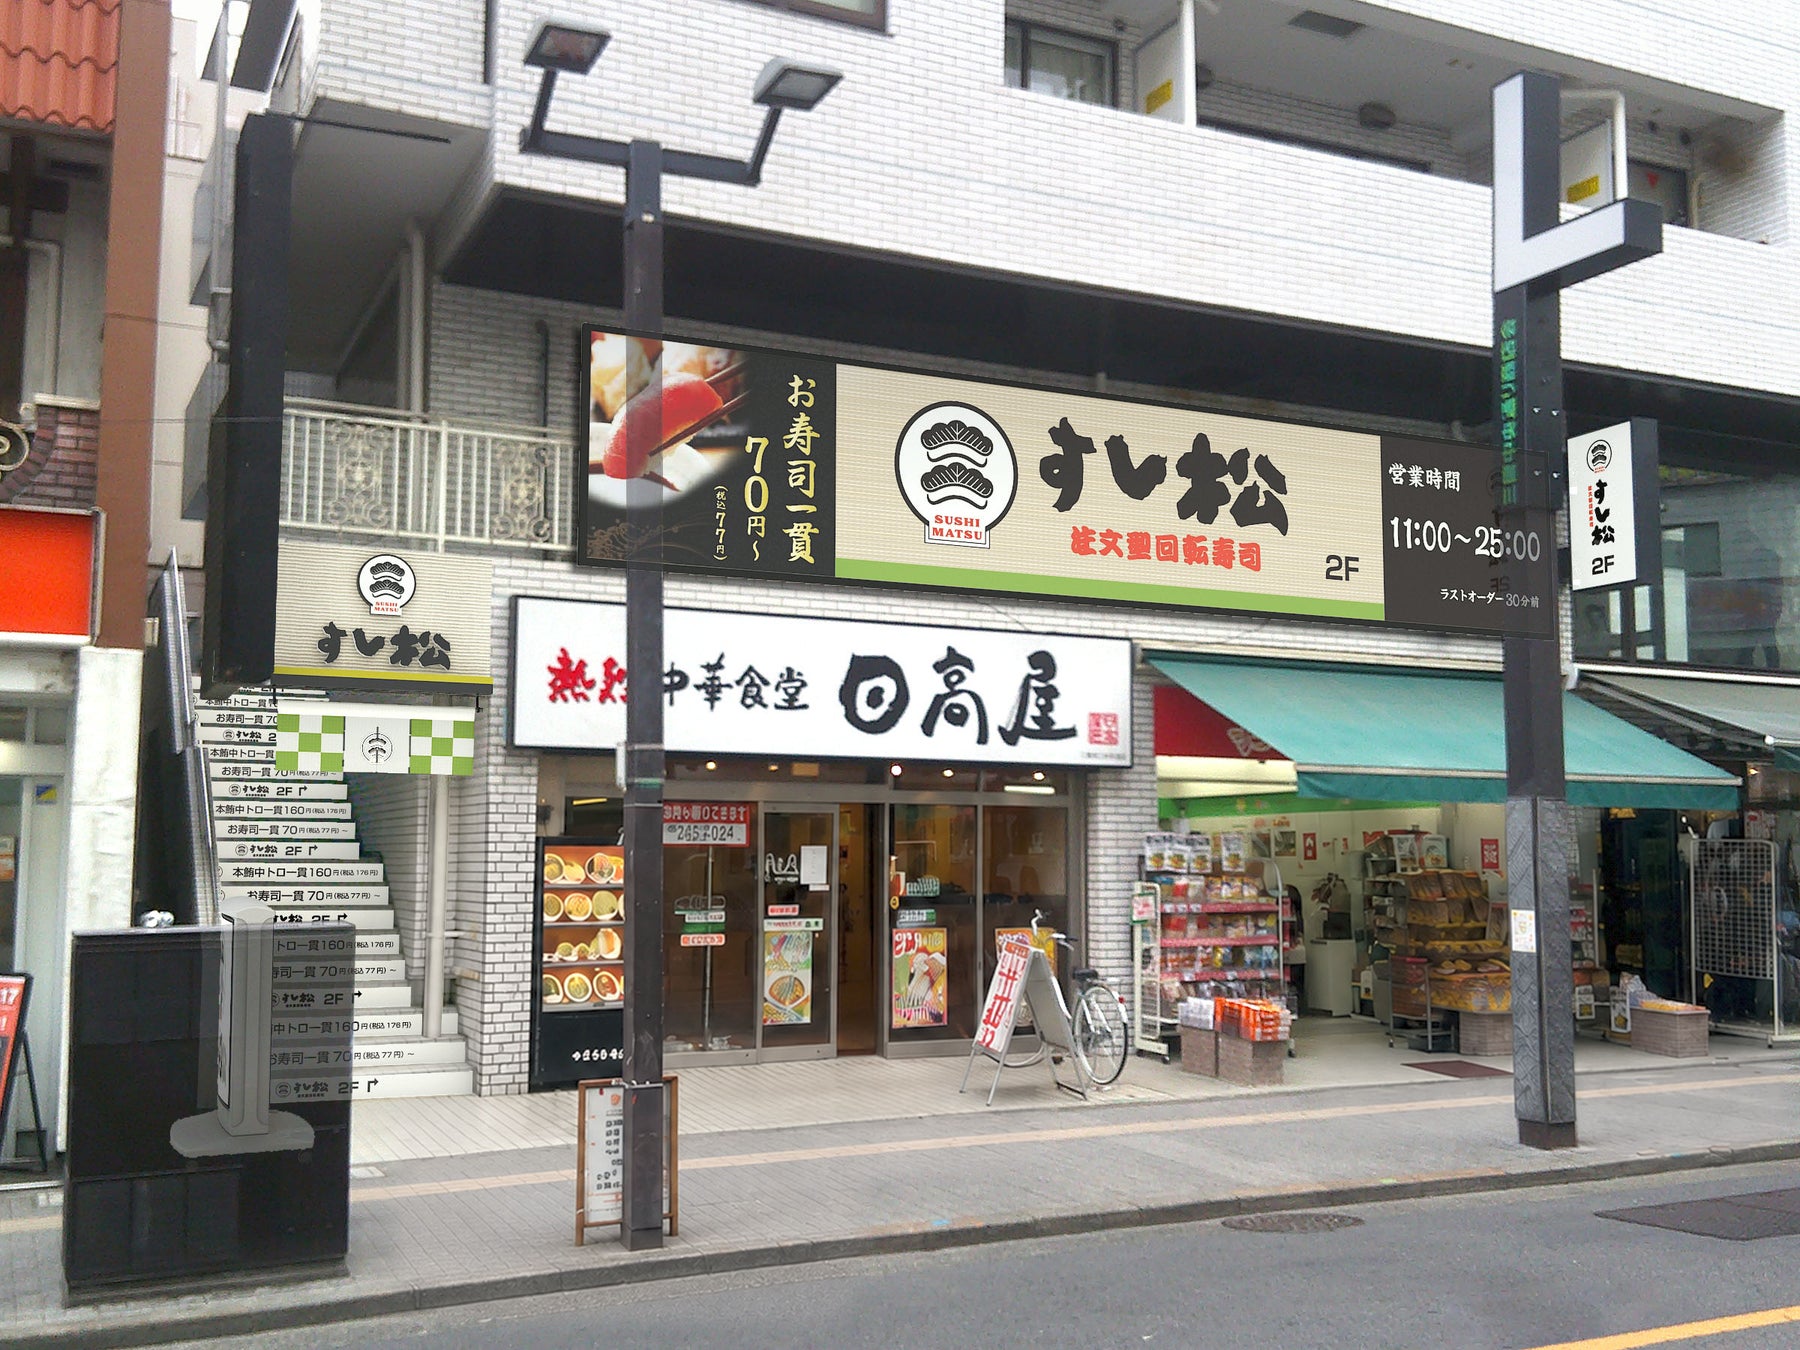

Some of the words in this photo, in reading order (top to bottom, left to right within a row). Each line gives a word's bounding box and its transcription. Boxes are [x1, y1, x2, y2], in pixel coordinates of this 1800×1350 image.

[782, 374, 820, 564] お寿司一貫
[1039, 417, 1288, 536] すし松
[1388, 463, 1461, 492] 営業時間
[713, 485, 729, 561] (税込77円)
[934, 515, 981, 528] SUSHI
[1591, 479, 1615, 546] すし松
[931, 528, 983, 541] MATSU
[1070, 525, 1262, 572] 注文型回転寿司
[1325, 554, 1360, 581] 2F
[1592, 555, 1615, 575] 2F
[317, 621, 452, 671] すし松
[840, 646, 1078, 745] 日高屋
[236, 731, 262, 739] すし松
[242, 785, 270, 794] すし松
[276, 787, 293, 796] 2F
[250, 844, 278, 854] すし松
[285, 847, 302, 856] 2F
[282, 992, 315, 1003] すし松
[324, 993, 344, 1005] 2F
[293, 1080, 329, 1094] すし松
[338, 1081, 359, 1094] 2F
